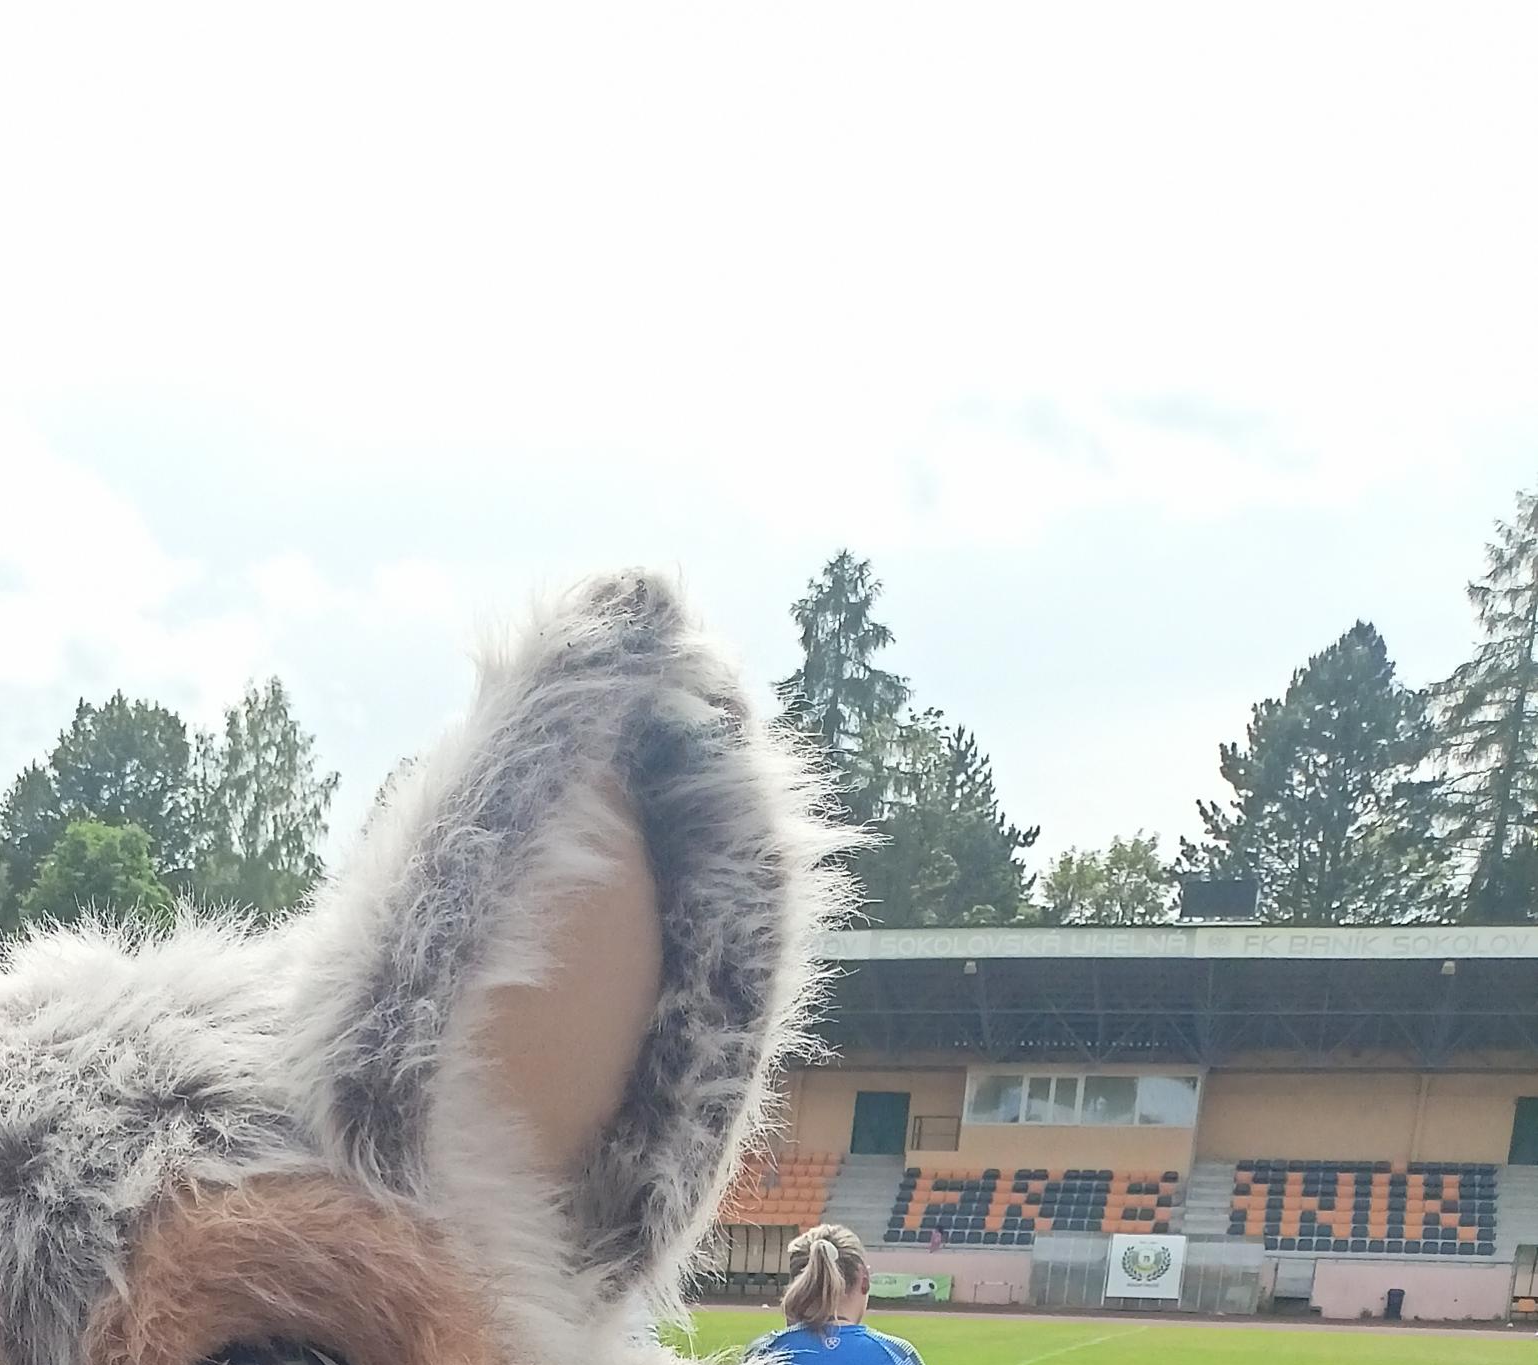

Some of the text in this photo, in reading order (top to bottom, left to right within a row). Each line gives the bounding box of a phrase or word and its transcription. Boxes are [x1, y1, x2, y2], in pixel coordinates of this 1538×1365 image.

[880, 931, 1060, 955] SOKOLOVSKÁ
[1070, 930, 1187, 954] UHELNÁ
[1244, 935, 1279, 955] FK
[1392, 934, 1531, 956] SOKOLOV
